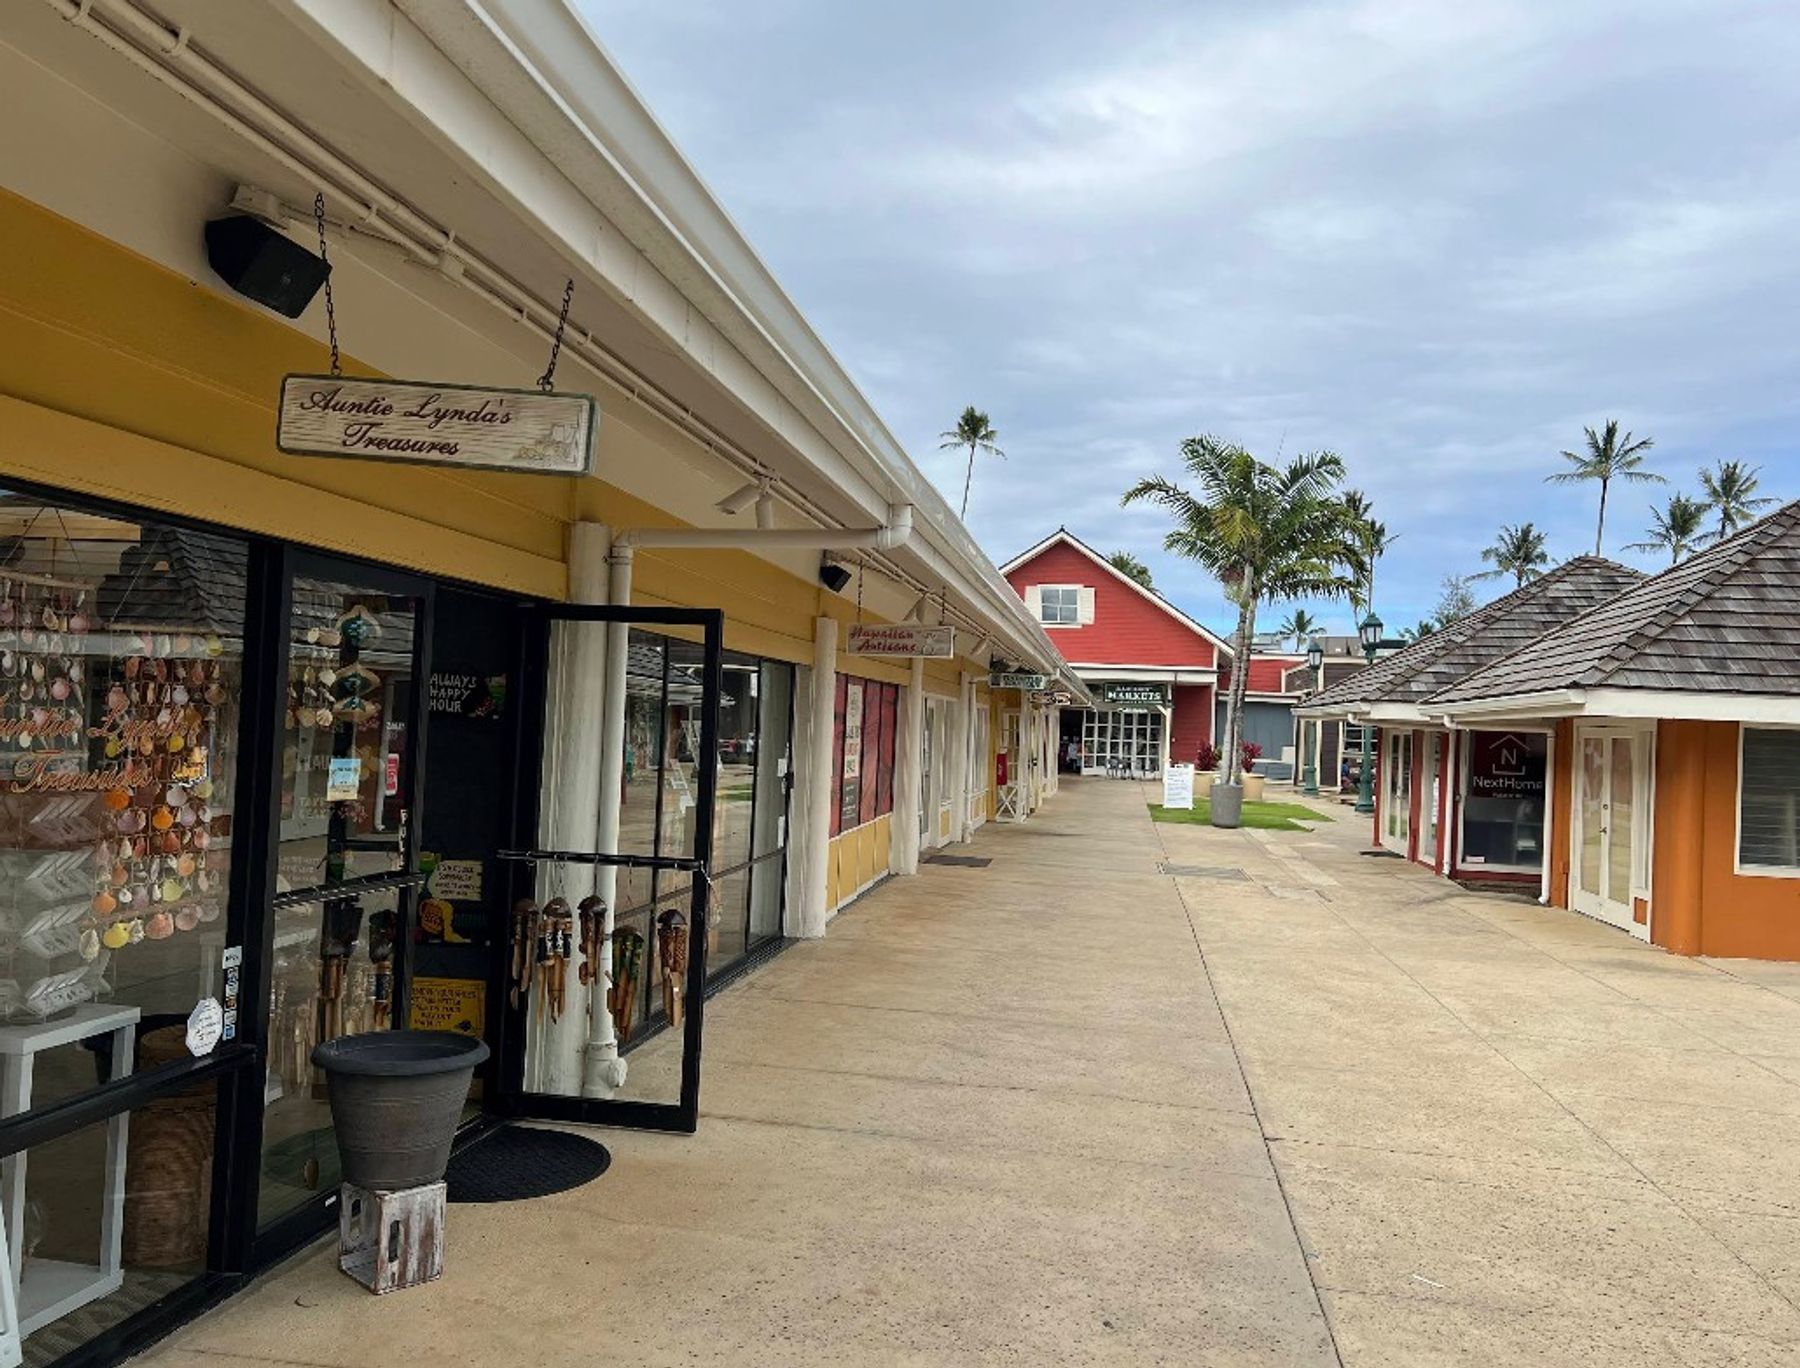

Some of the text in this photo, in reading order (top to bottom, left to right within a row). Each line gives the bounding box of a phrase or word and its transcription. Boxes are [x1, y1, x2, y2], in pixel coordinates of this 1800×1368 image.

[300, 387, 513, 429] Auntie Lynda's
[341, 422, 460, 456] Treasures
[849, 626, 914, 639] Hawaiian
[429, 672, 477, 688] ALWAYS
[429, 686, 471, 700] HAPPY
[1107, 691, 1162, 700] MARKETS
[428, 699, 462, 712] HOUR
